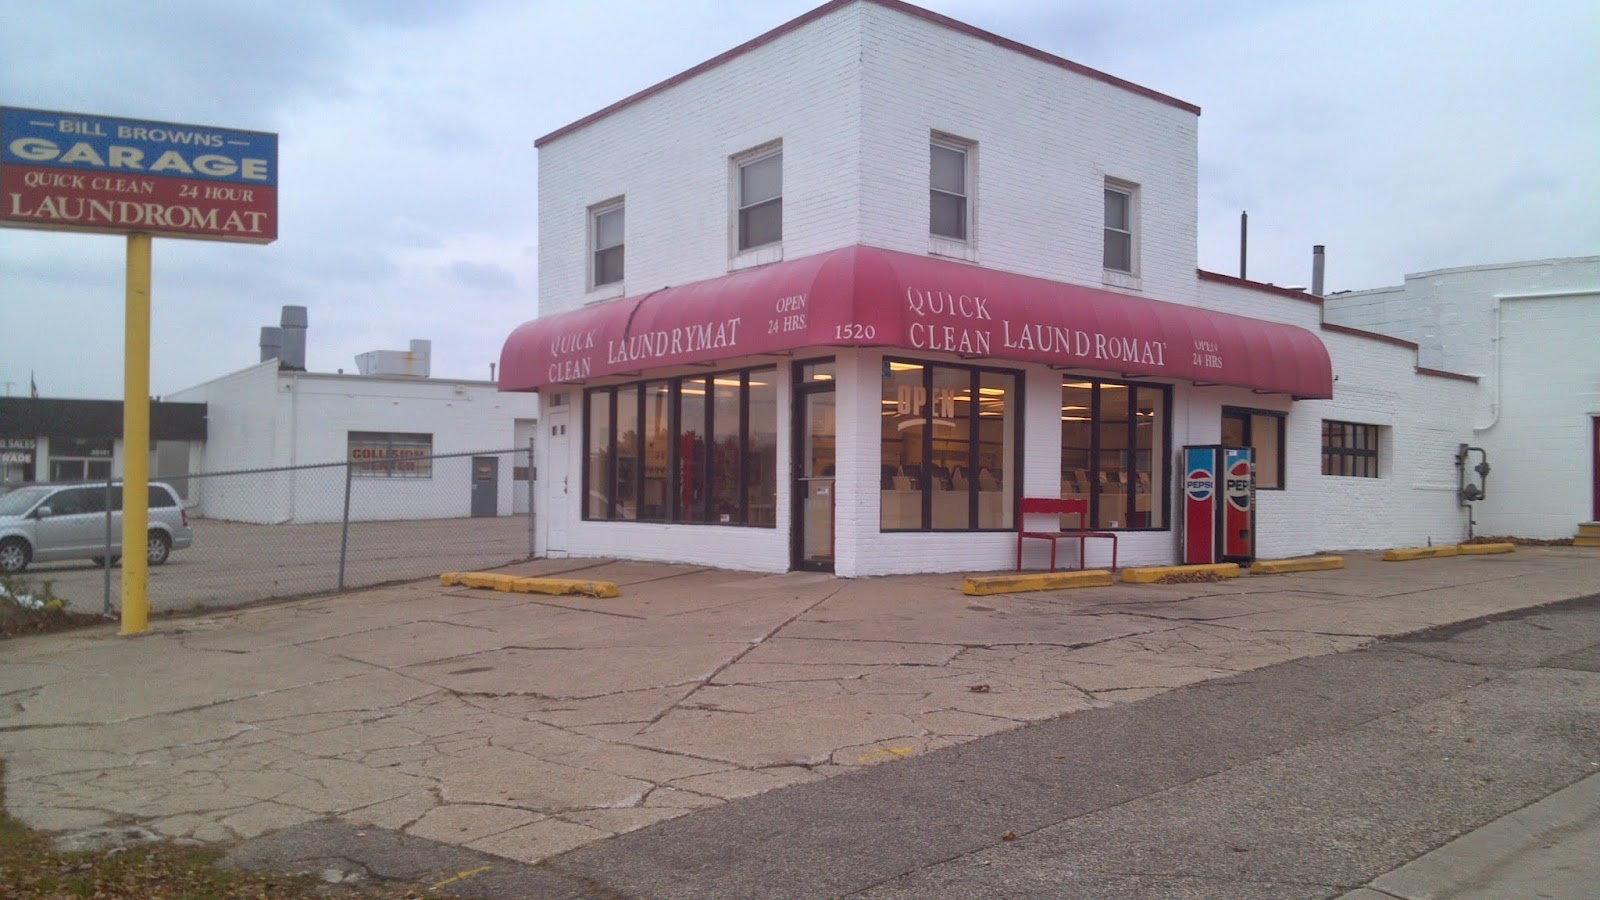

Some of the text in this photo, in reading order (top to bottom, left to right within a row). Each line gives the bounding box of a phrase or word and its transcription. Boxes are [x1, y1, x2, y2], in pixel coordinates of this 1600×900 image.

[59, 119, 224, 147] BILL BROWNS
[9, 137, 268, 180] GARAGE
[24, 171, 254, 202] QUICK CLEAN 24 HOUR
[9, 192, 268, 233] LAUNDROMAT
[776, 293, 807, 313] OPEN
[907, 286, 992, 321] QUICK
[767, 314, 807, 334] 24 HRS.
[835, 323, 876, 340] 1520
[909, 322, 992, 355] CLEAN
[550, 327, 598, 358] QUICK
[607, 317, 741, 364] LAUNDRYMAT
[1002, 319, 1168, 366] LAUNDROMAT
[1194, 338, 1219, 353] OPEN
[548, 356, 592, 384] CLEAN
[1192, 352, 1223, 369] 24 HRS
[897, 385, 955, 418] OPEN
[8, 438, 36, 450] SALES
[1187, 481, 1213, 489] PEPSI
